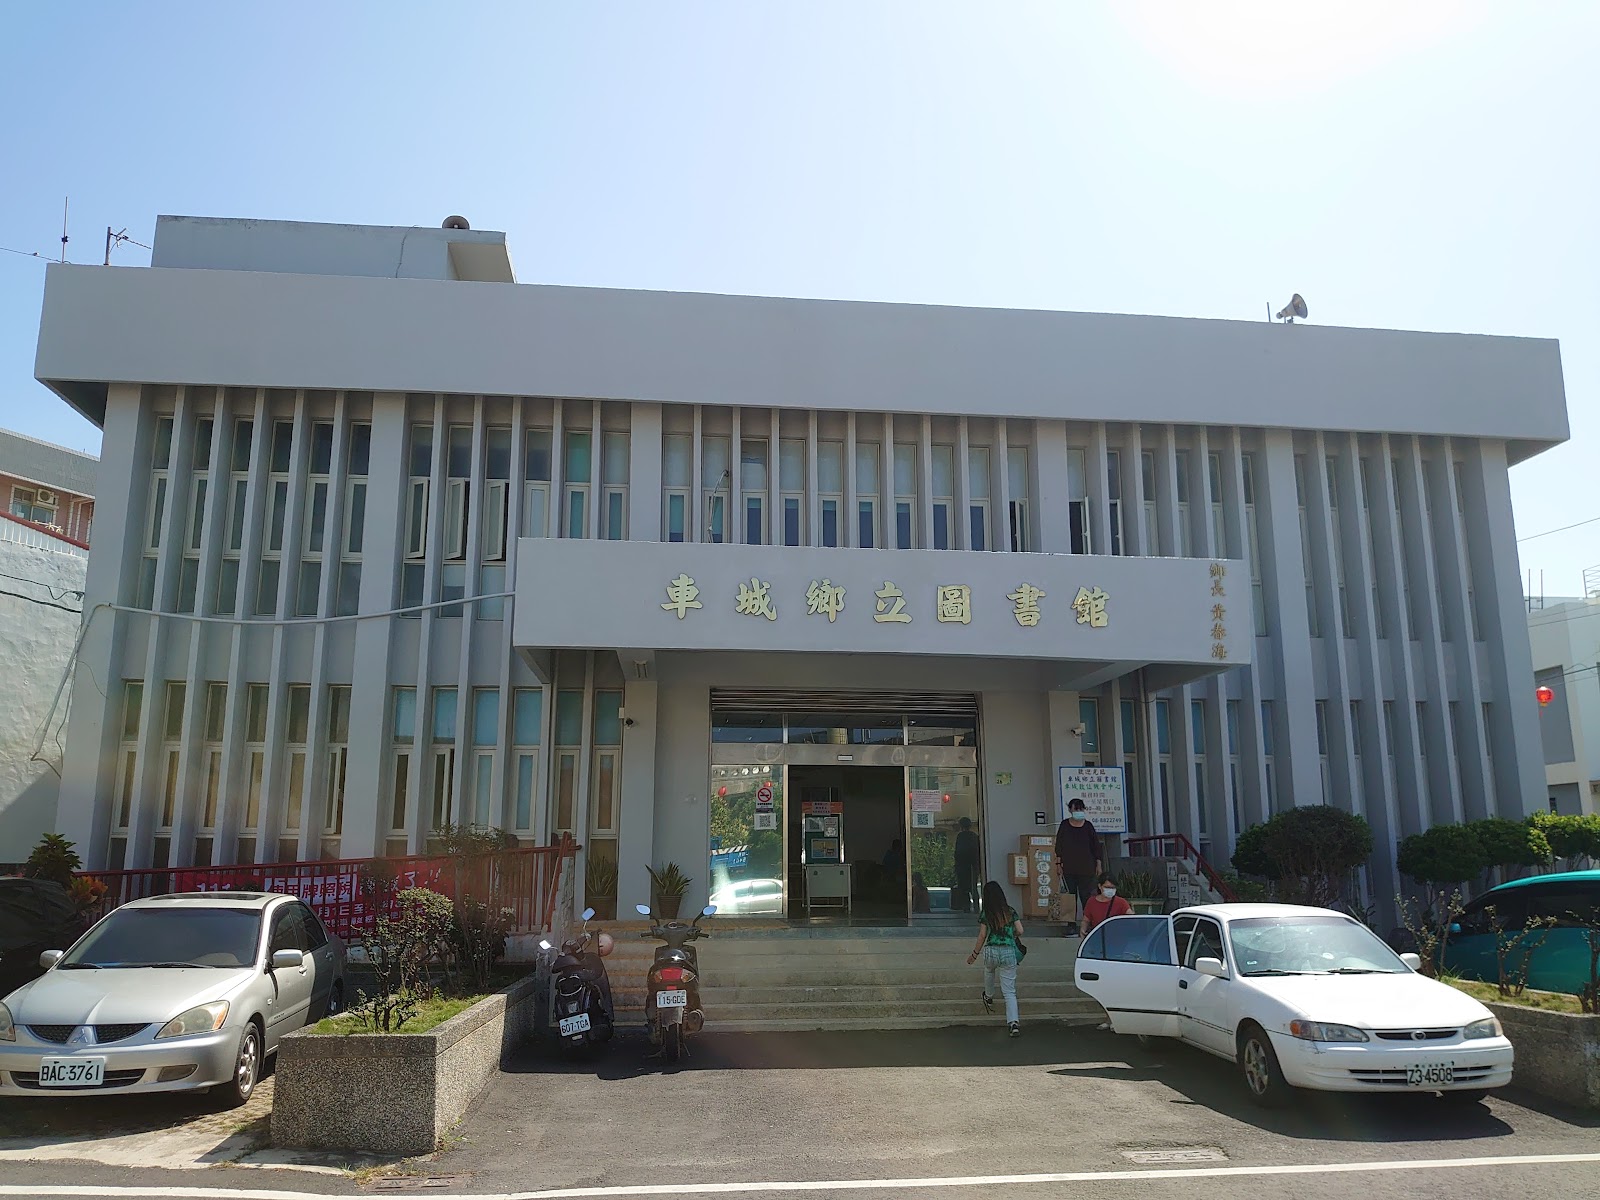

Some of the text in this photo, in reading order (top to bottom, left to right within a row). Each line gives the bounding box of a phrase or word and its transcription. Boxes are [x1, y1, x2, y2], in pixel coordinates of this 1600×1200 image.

[660, 573, 1111, 628] 車城鄉立圖書館
